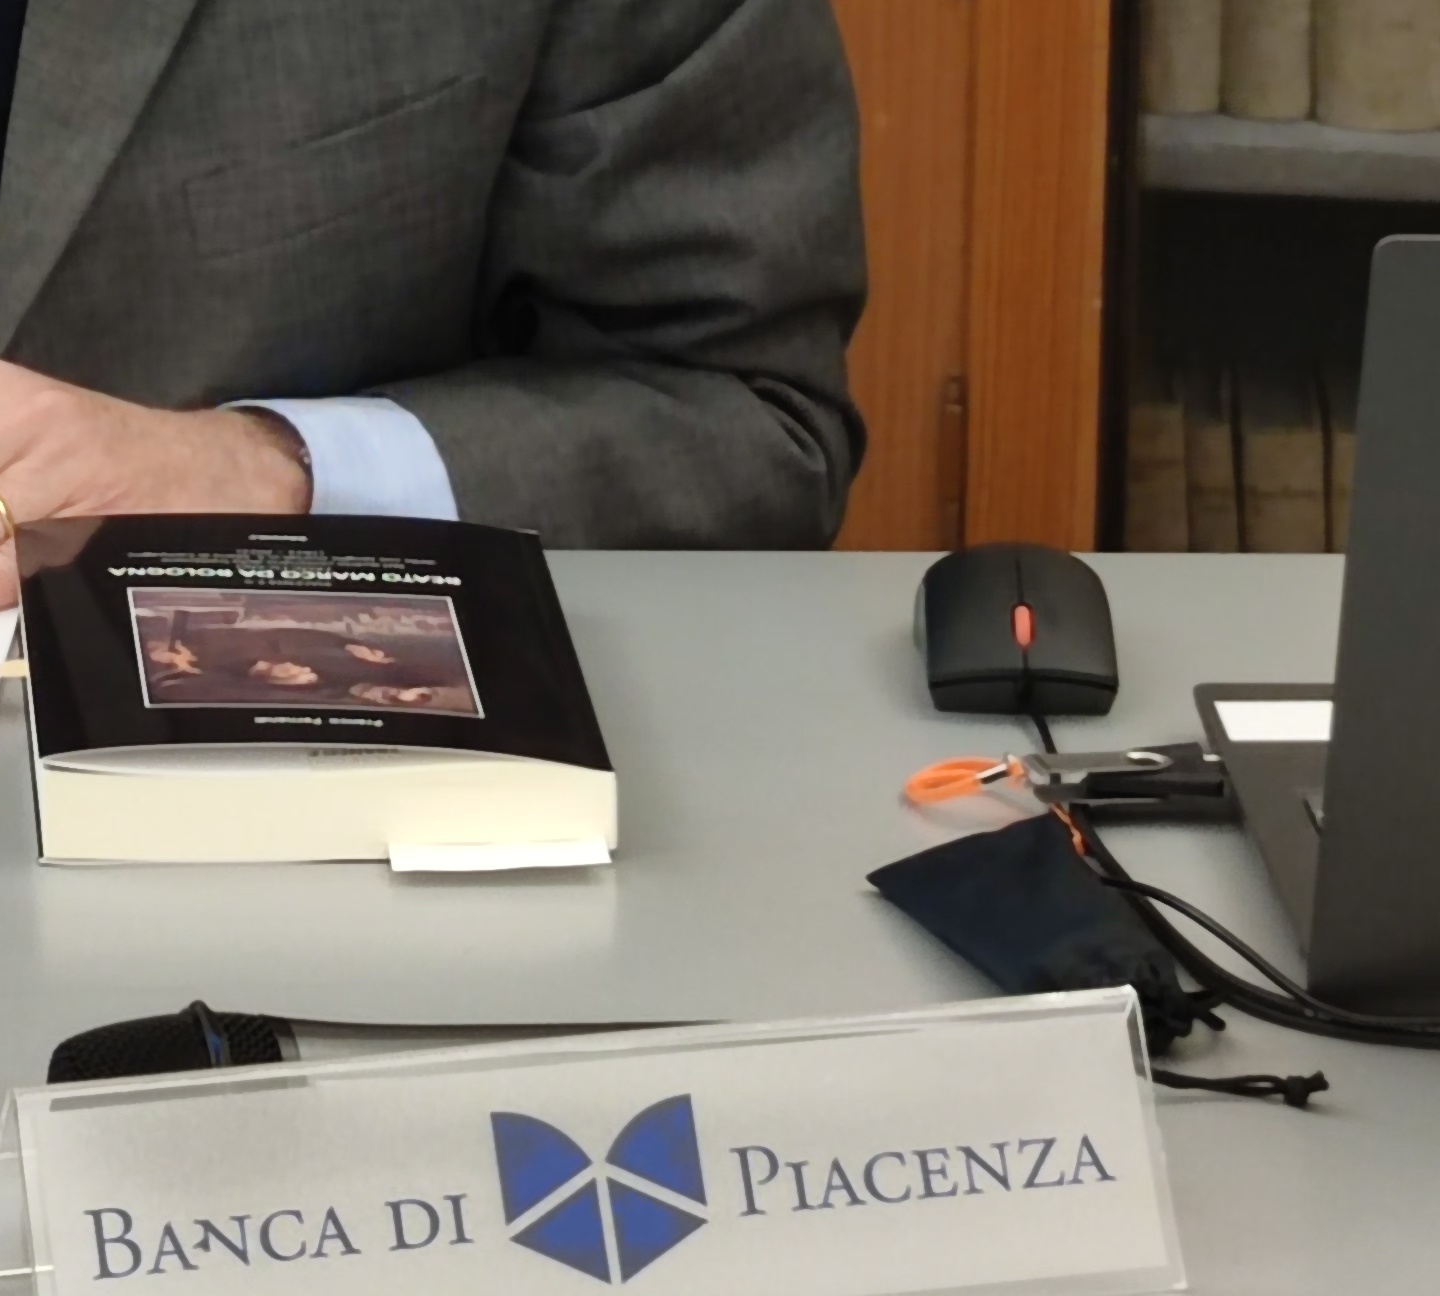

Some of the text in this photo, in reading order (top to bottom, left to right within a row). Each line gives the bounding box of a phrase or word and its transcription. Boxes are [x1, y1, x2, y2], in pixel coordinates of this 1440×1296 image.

[279, 569, 376, 582] MARCO
[381, 571, 462, 586] BEATO
[82, 1133, 1118, 1281] BANCA DI PIACENZA
